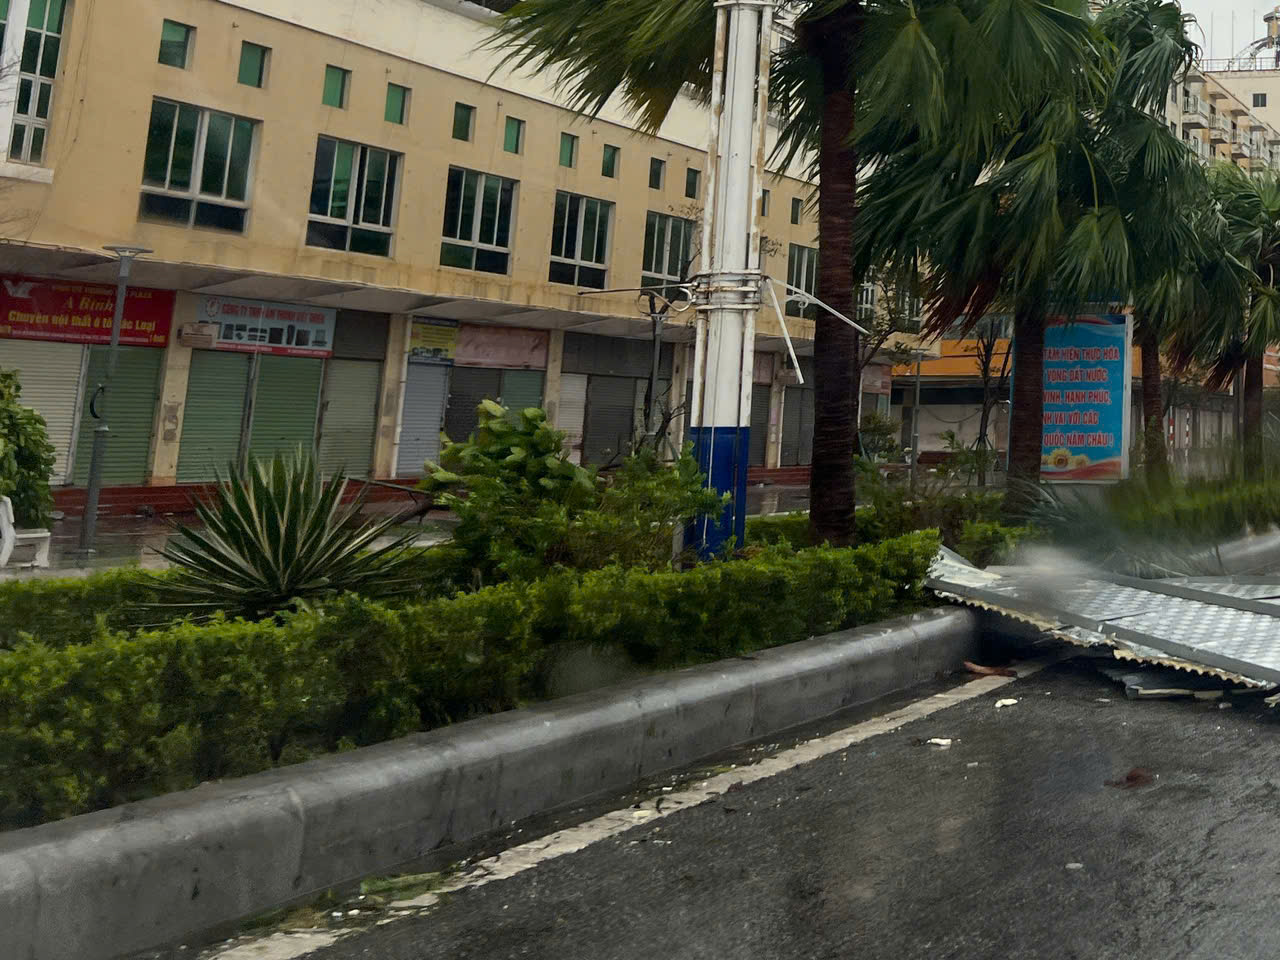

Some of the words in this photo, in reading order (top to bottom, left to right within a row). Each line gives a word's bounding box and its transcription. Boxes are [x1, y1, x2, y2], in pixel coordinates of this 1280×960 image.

[1062, 345, 1080, 363] HIỆN
[1083, 347, 1101, 363] THỰC
[1065, 391, 1086, 407] HẠNH
[1055, 412, 1066, 424] VAI
